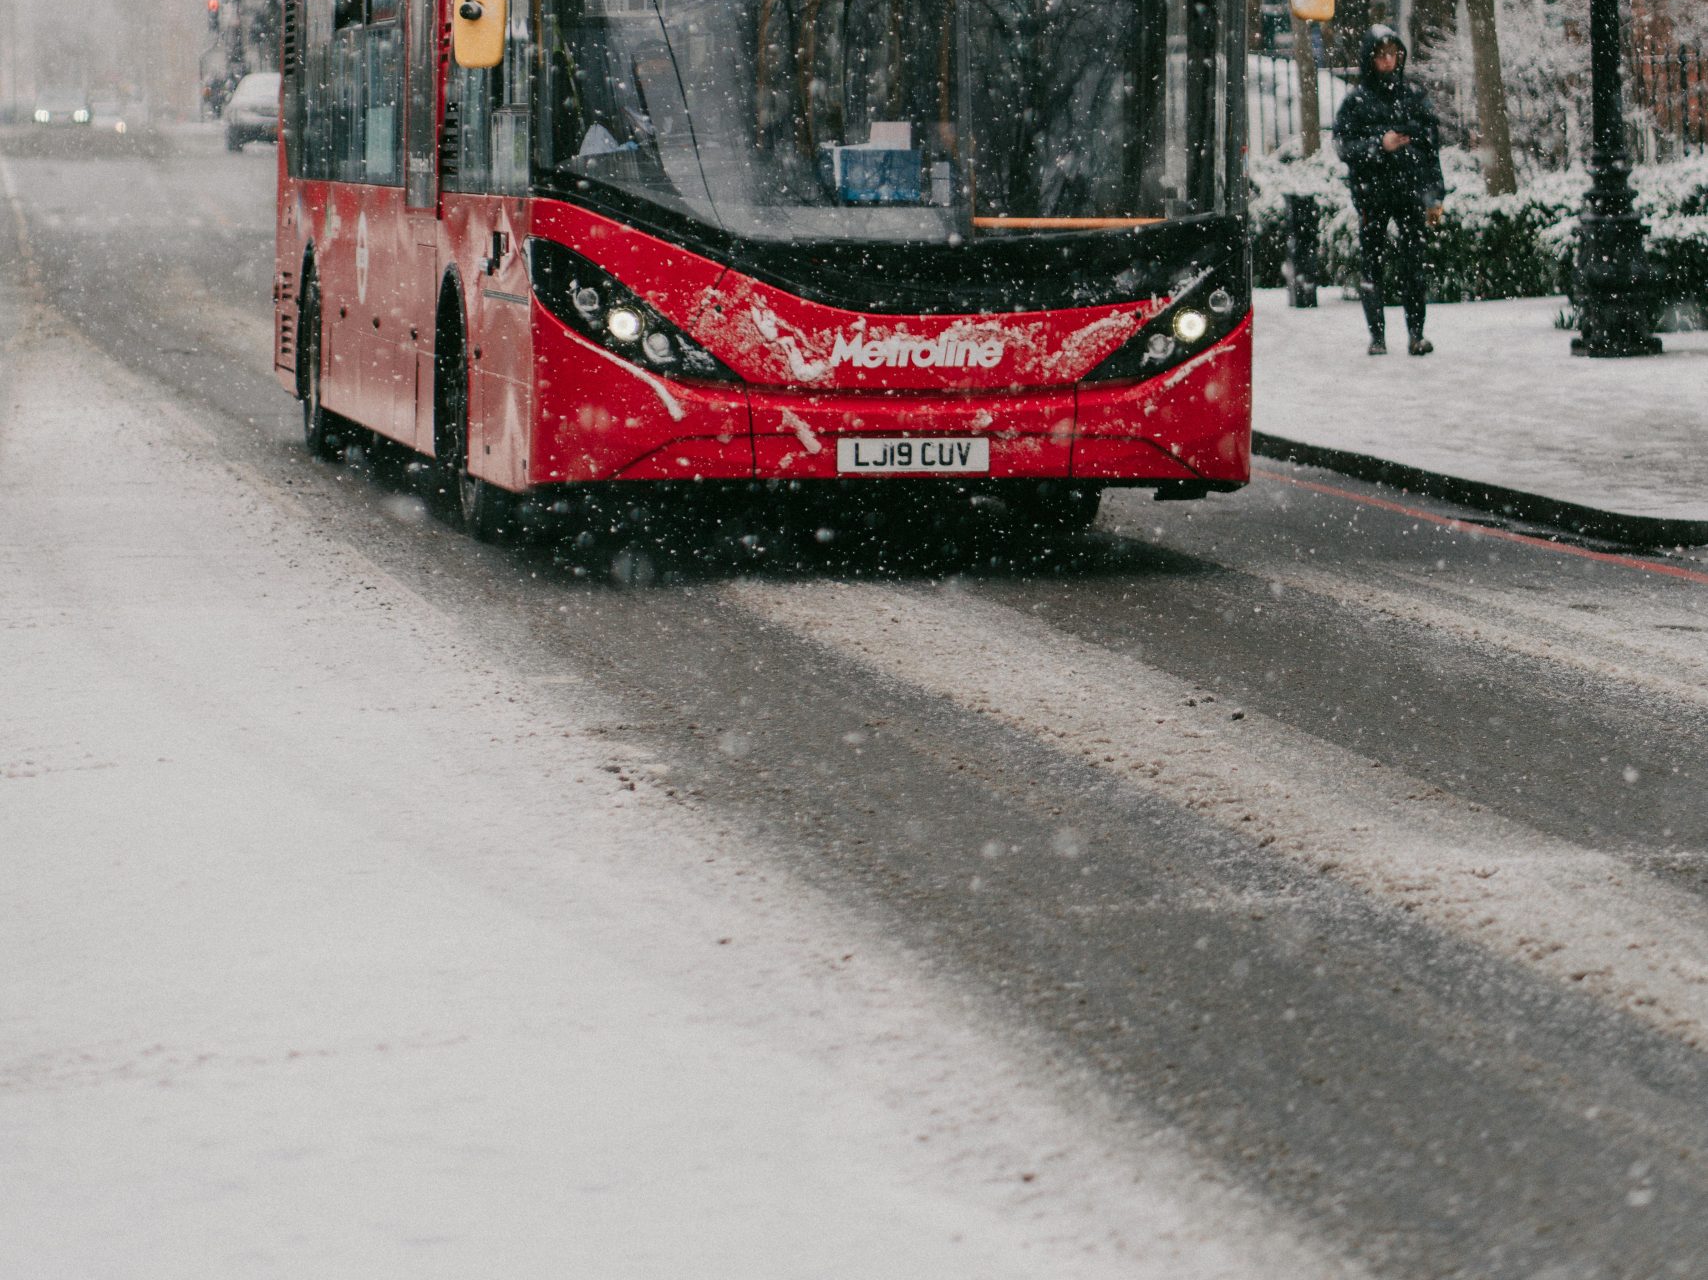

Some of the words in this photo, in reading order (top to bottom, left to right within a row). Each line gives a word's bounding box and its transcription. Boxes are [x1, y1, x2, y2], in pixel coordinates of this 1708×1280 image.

[829, 332, 1005, 369] Metroline
[854, 442, 912, 467] LJ19
[921, 442, 971, 466] CUV
